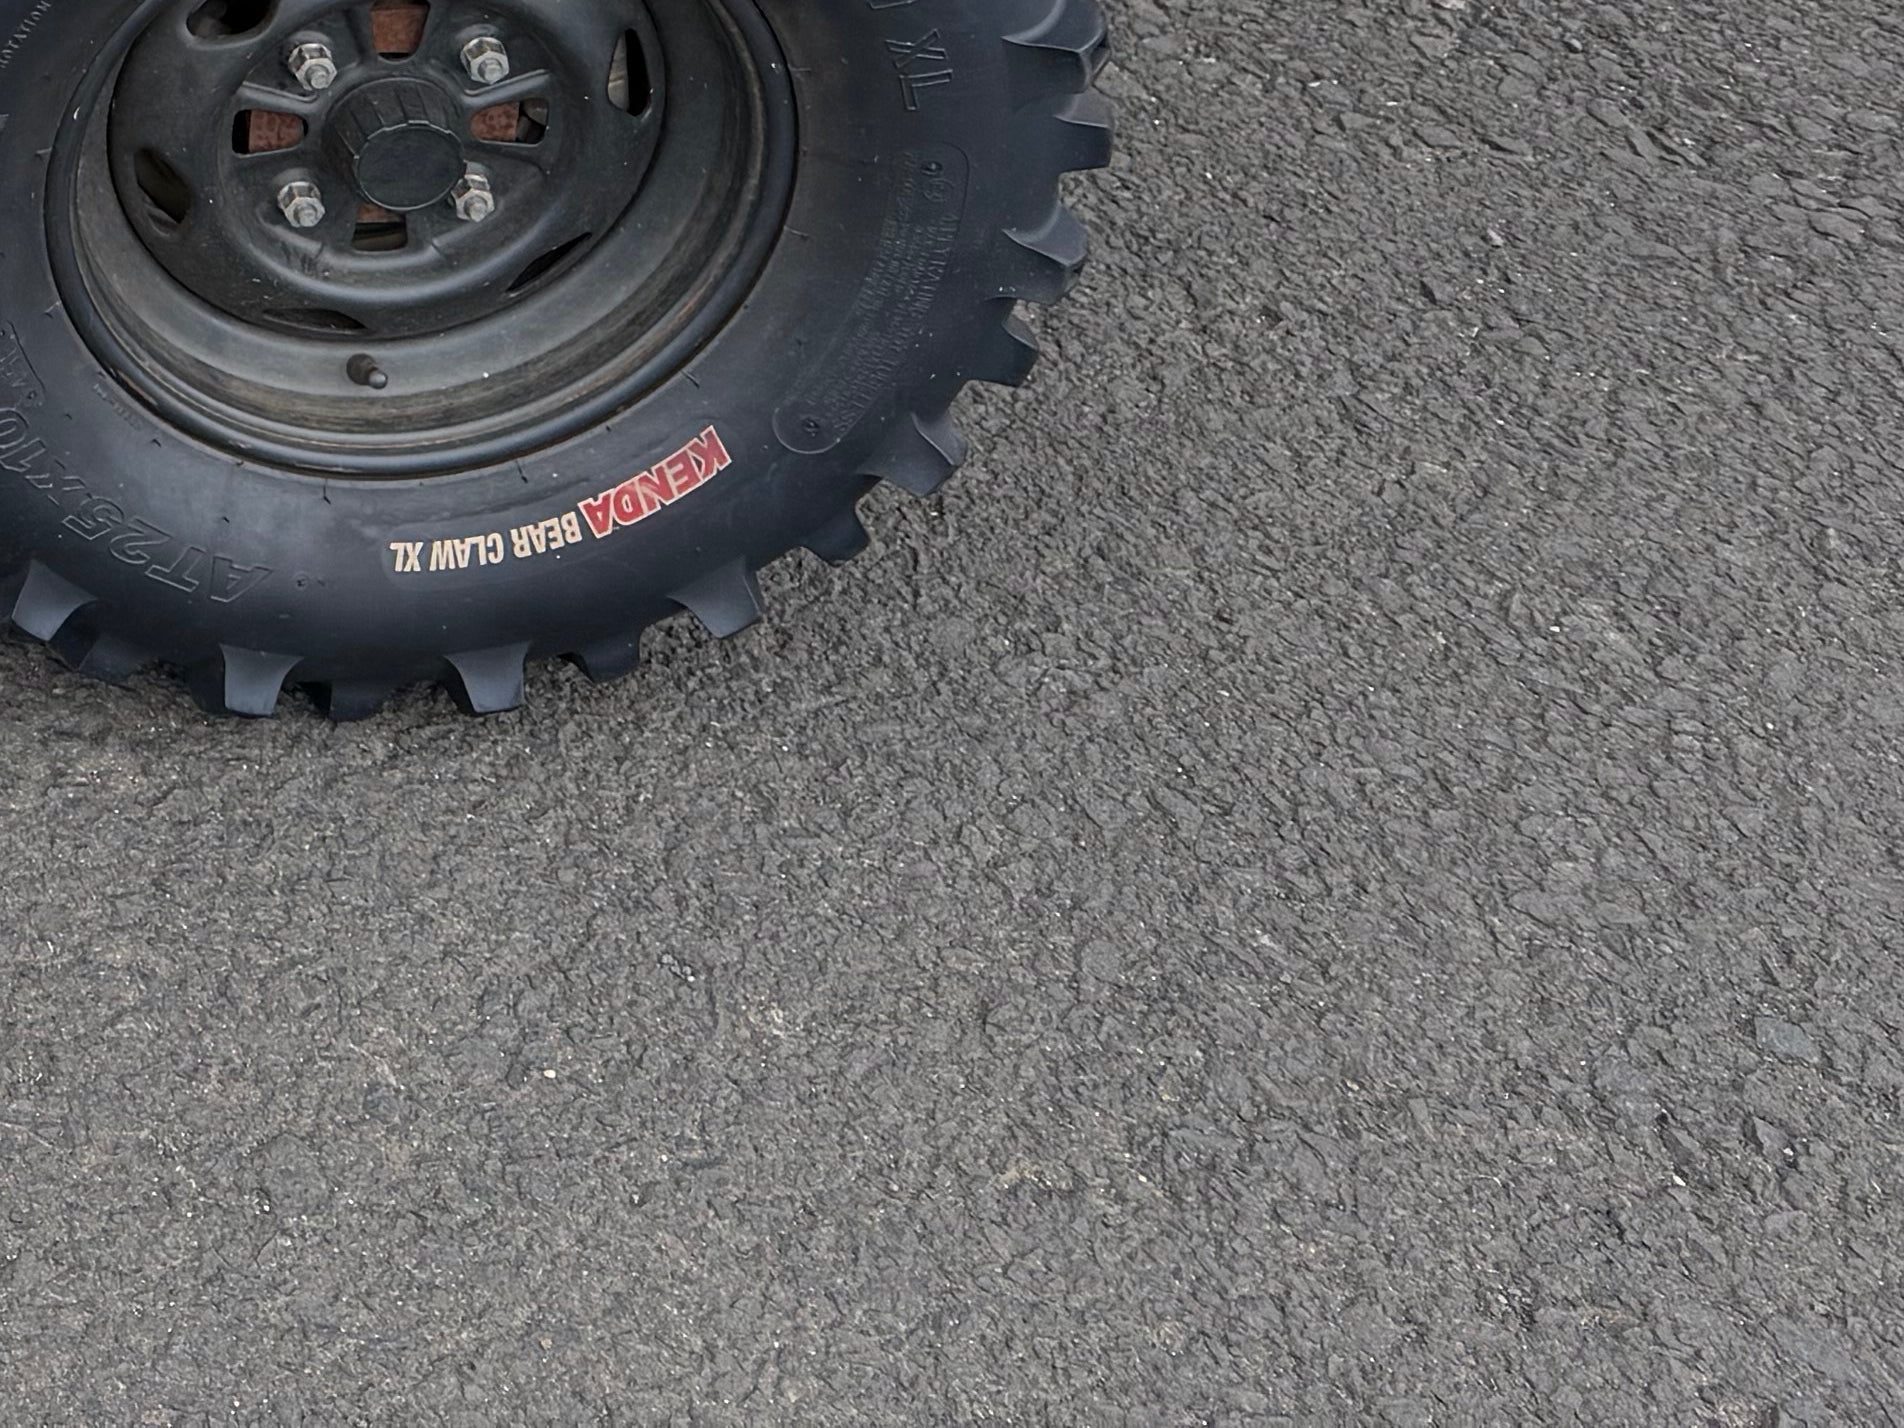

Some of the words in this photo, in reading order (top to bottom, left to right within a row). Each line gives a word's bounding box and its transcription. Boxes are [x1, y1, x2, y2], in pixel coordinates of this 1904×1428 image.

[886, 28, 953, 111] XL
[577, 425, 733, 539] KENDA
[390, 541, 425, 572] XL
[429, 533, 504, 572] CLAW
[511, 511, 583, 559] BEAR
